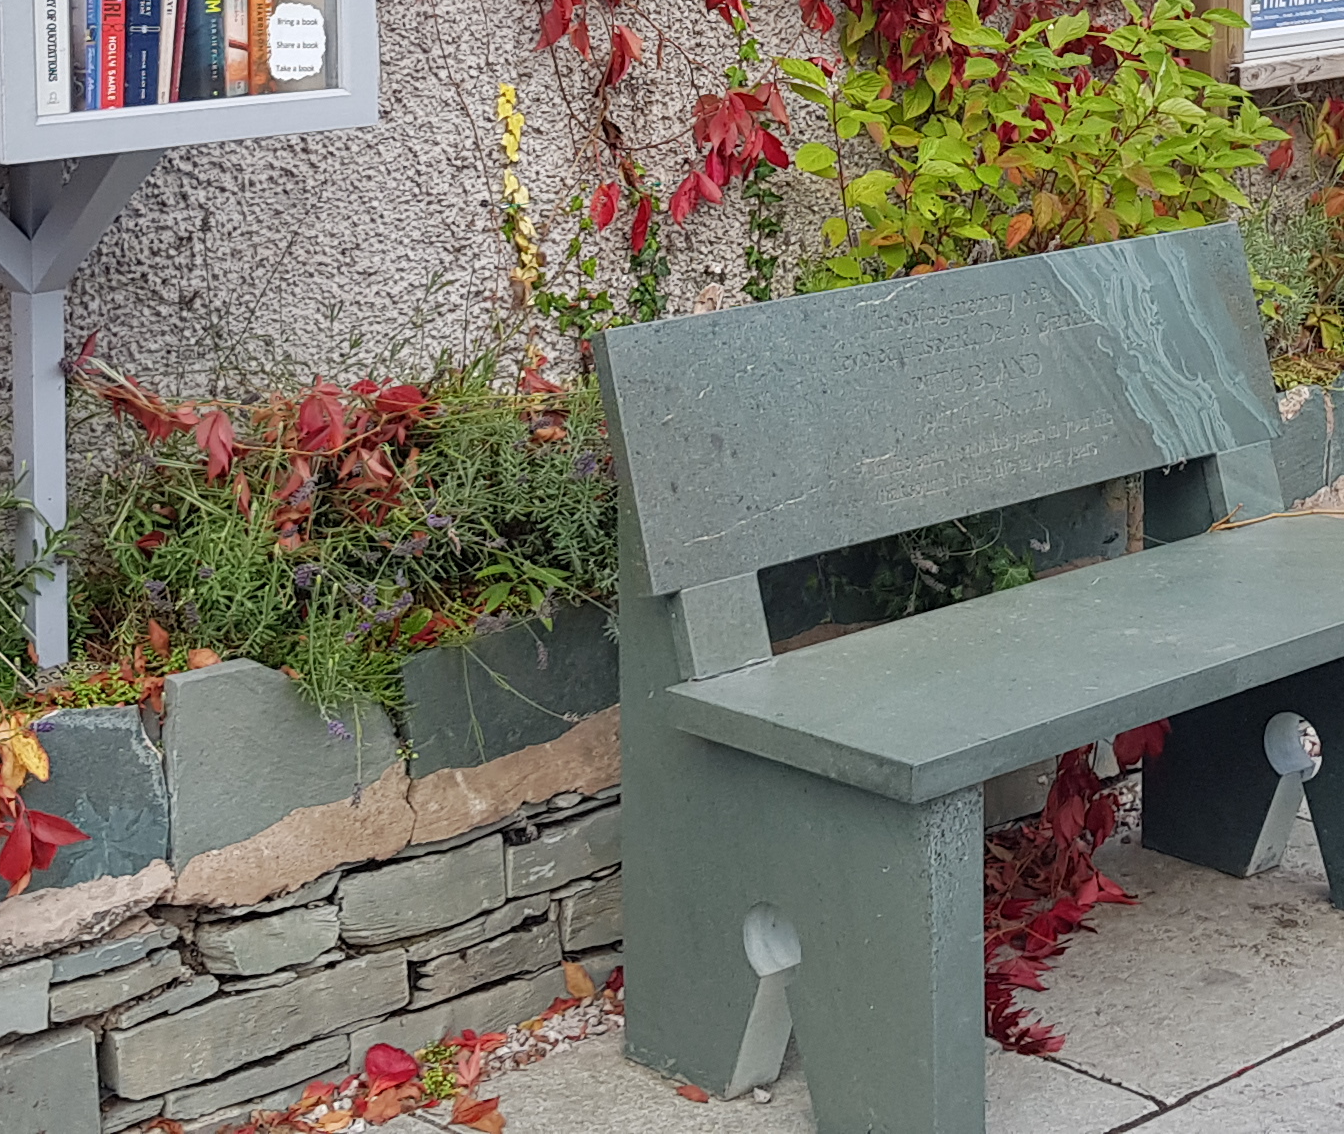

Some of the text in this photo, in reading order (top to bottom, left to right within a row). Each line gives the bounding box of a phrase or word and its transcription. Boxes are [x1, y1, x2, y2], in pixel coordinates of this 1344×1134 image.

[47, 9, 57, 21] OF
[302, 18, 318, 26] book
[276, 41, 295, 49] Share
[302, 41, 319, 49] book
[46, 23, 58, 82] QUOTATIONS
[107, 35, 117, 101] HOLLY SMALE
[276, 64, 291, 72] Take
[298, 64, 315, 72] book
[952, 293, 1016, 320] memory
